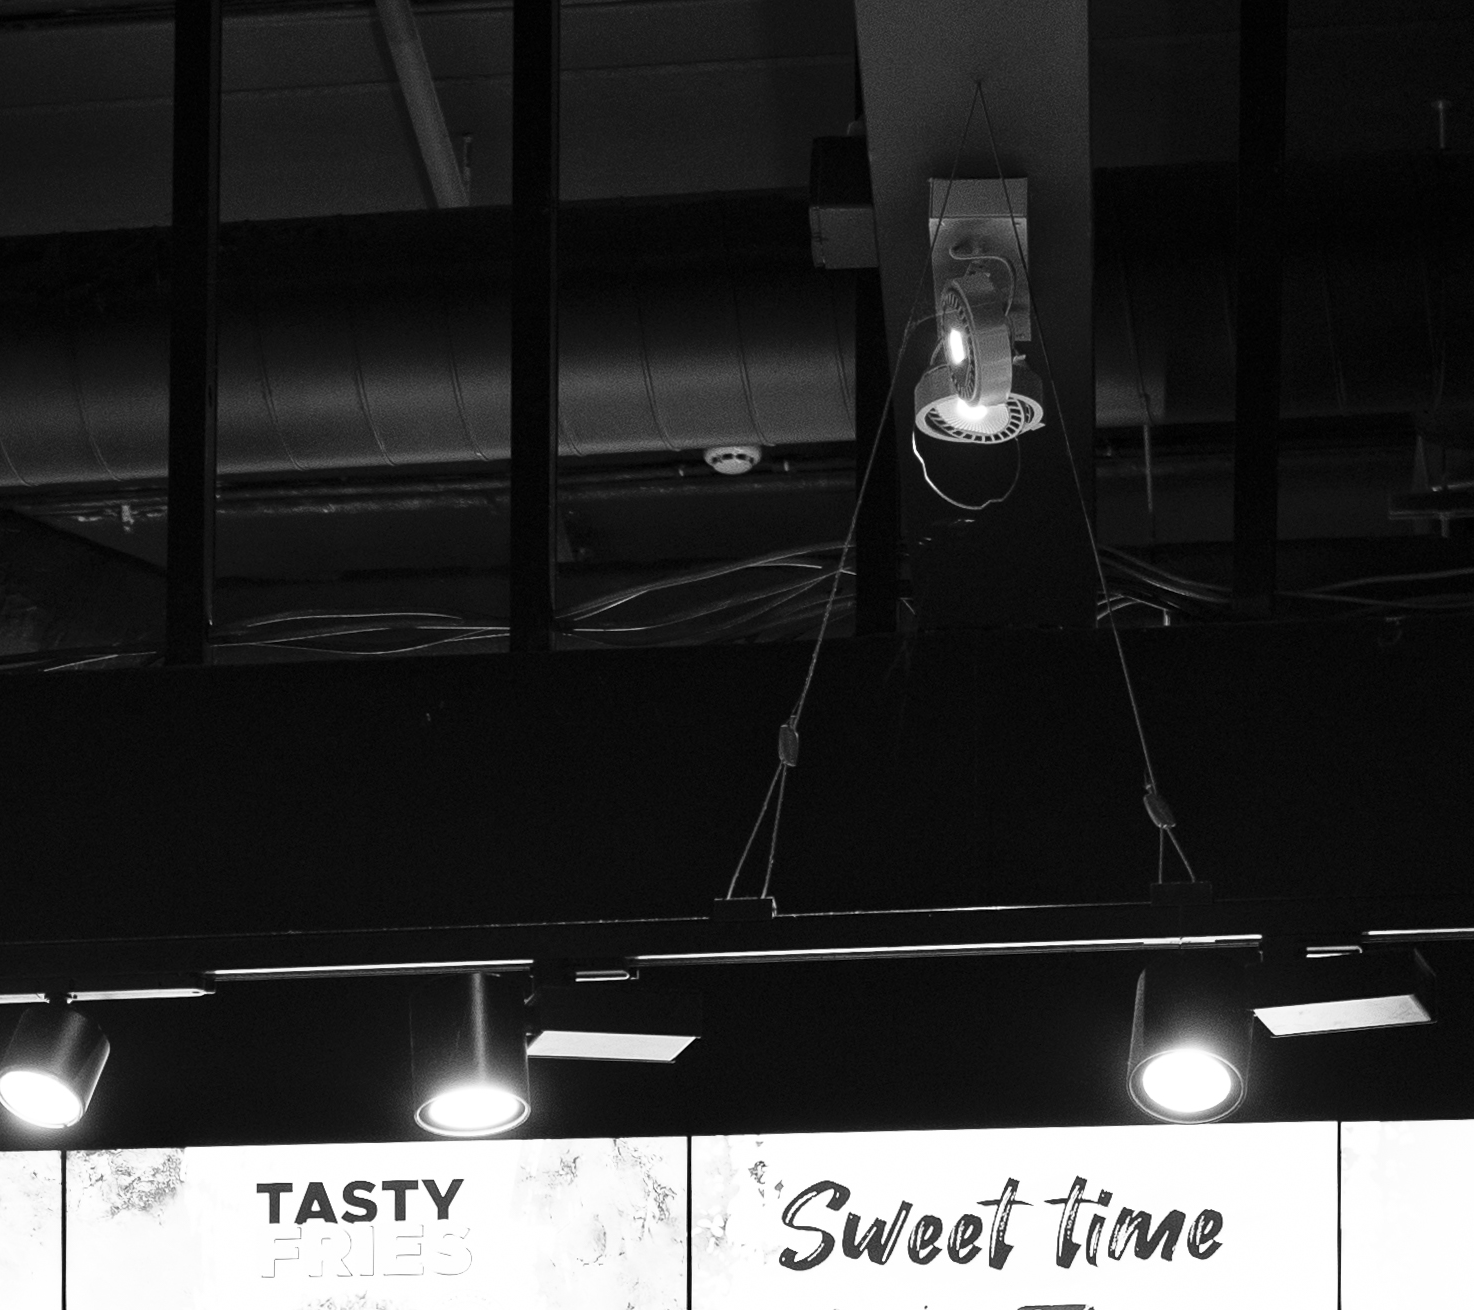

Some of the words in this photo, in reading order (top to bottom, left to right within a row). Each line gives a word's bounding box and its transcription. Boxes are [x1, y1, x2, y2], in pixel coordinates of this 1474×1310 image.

[256, 1178, 465, 1225] TASTY
[777, 1176, 1034, 1272] Sweet
[1044, 1175, 1224, 1267] time
[257, 1223, 474, 1279] FRIES
